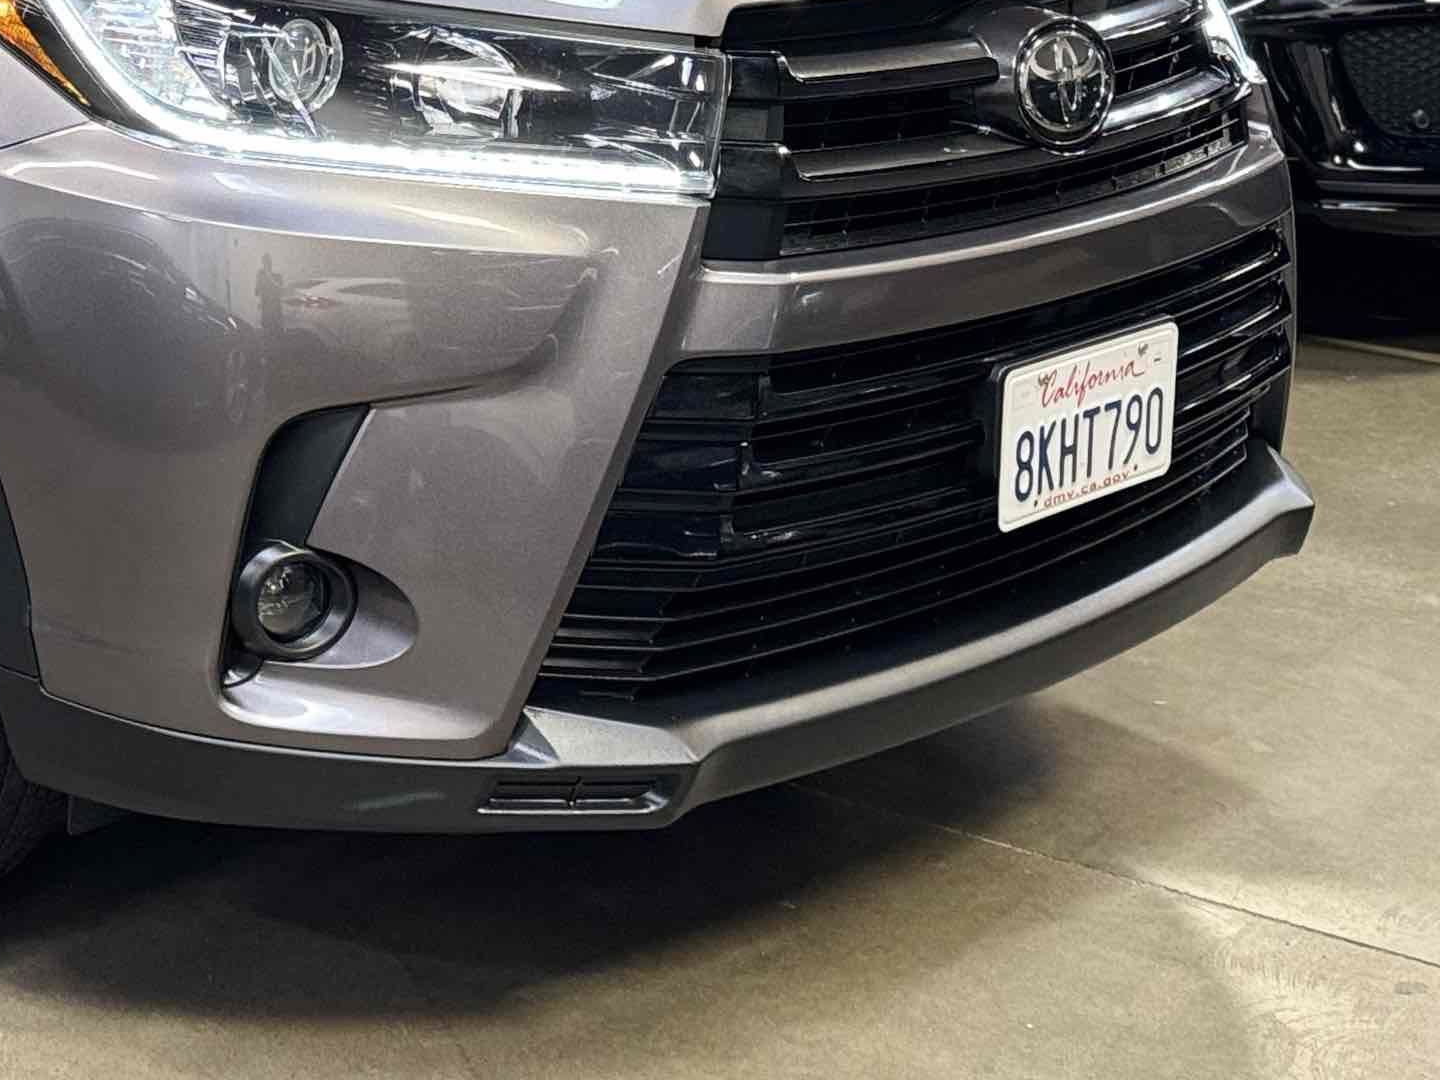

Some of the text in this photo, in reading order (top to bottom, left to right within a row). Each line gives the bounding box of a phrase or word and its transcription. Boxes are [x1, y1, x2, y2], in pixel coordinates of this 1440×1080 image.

[1038, 359, 1144, 408] California
[1015, 387, 1164, 502] 8KHT790
[1044, 469, 1131, 509] dmv.ca.gov
